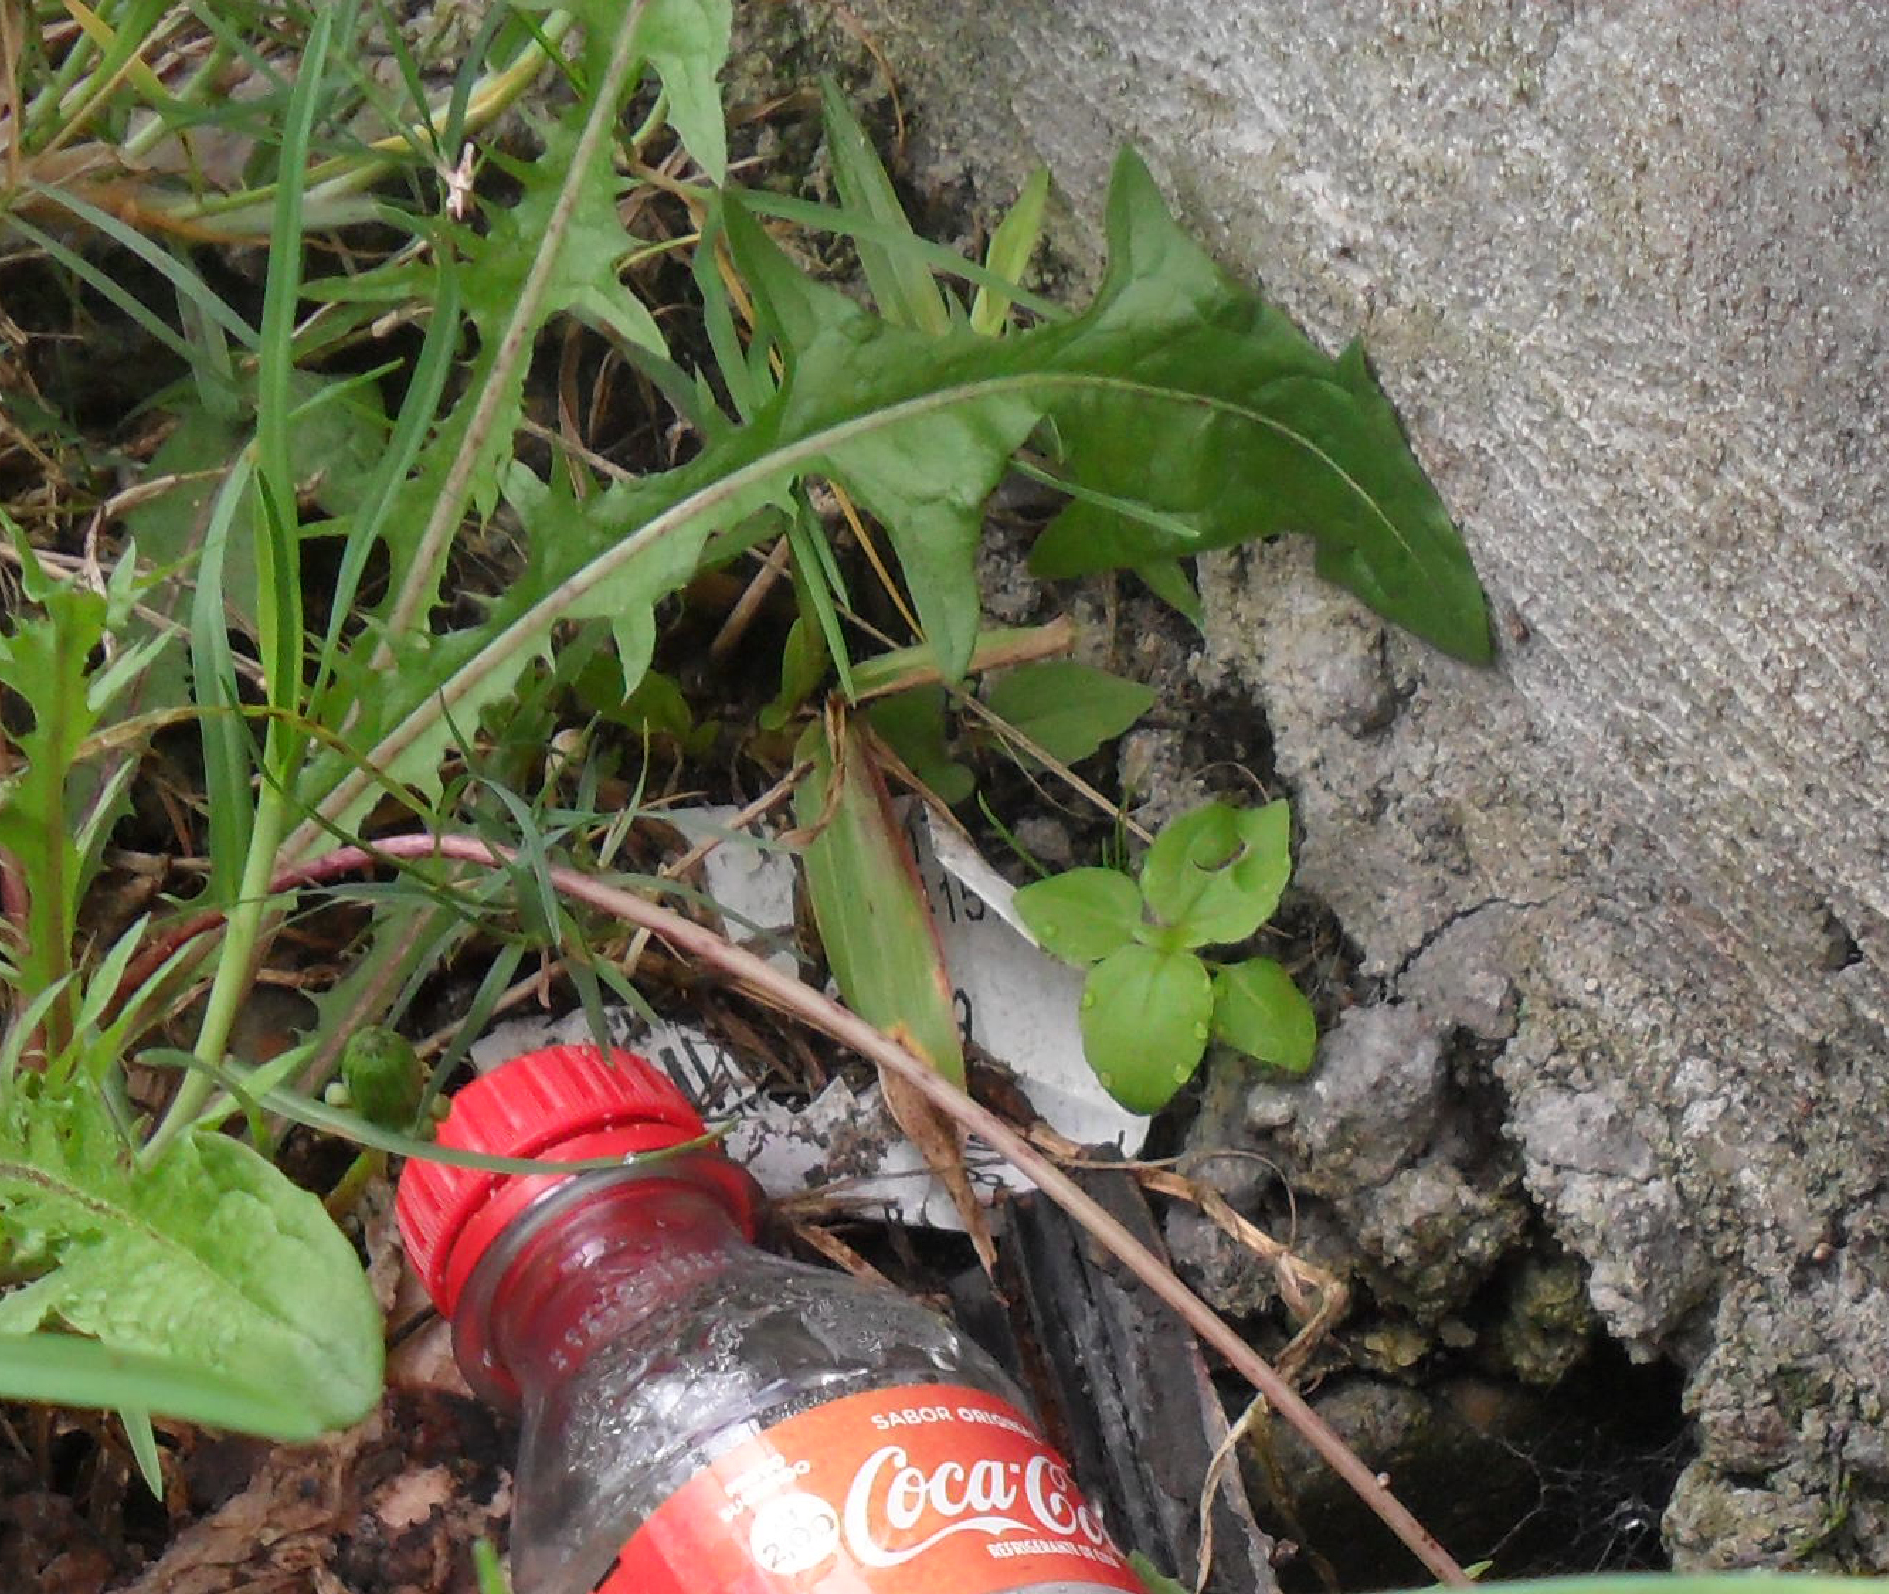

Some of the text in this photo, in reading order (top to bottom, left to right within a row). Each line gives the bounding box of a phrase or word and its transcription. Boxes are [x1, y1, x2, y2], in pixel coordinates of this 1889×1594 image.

[871, 1406, 1043, 1446] SABOR ORIGIN
[845, 1445, 1127, 1567] Coca-Co
